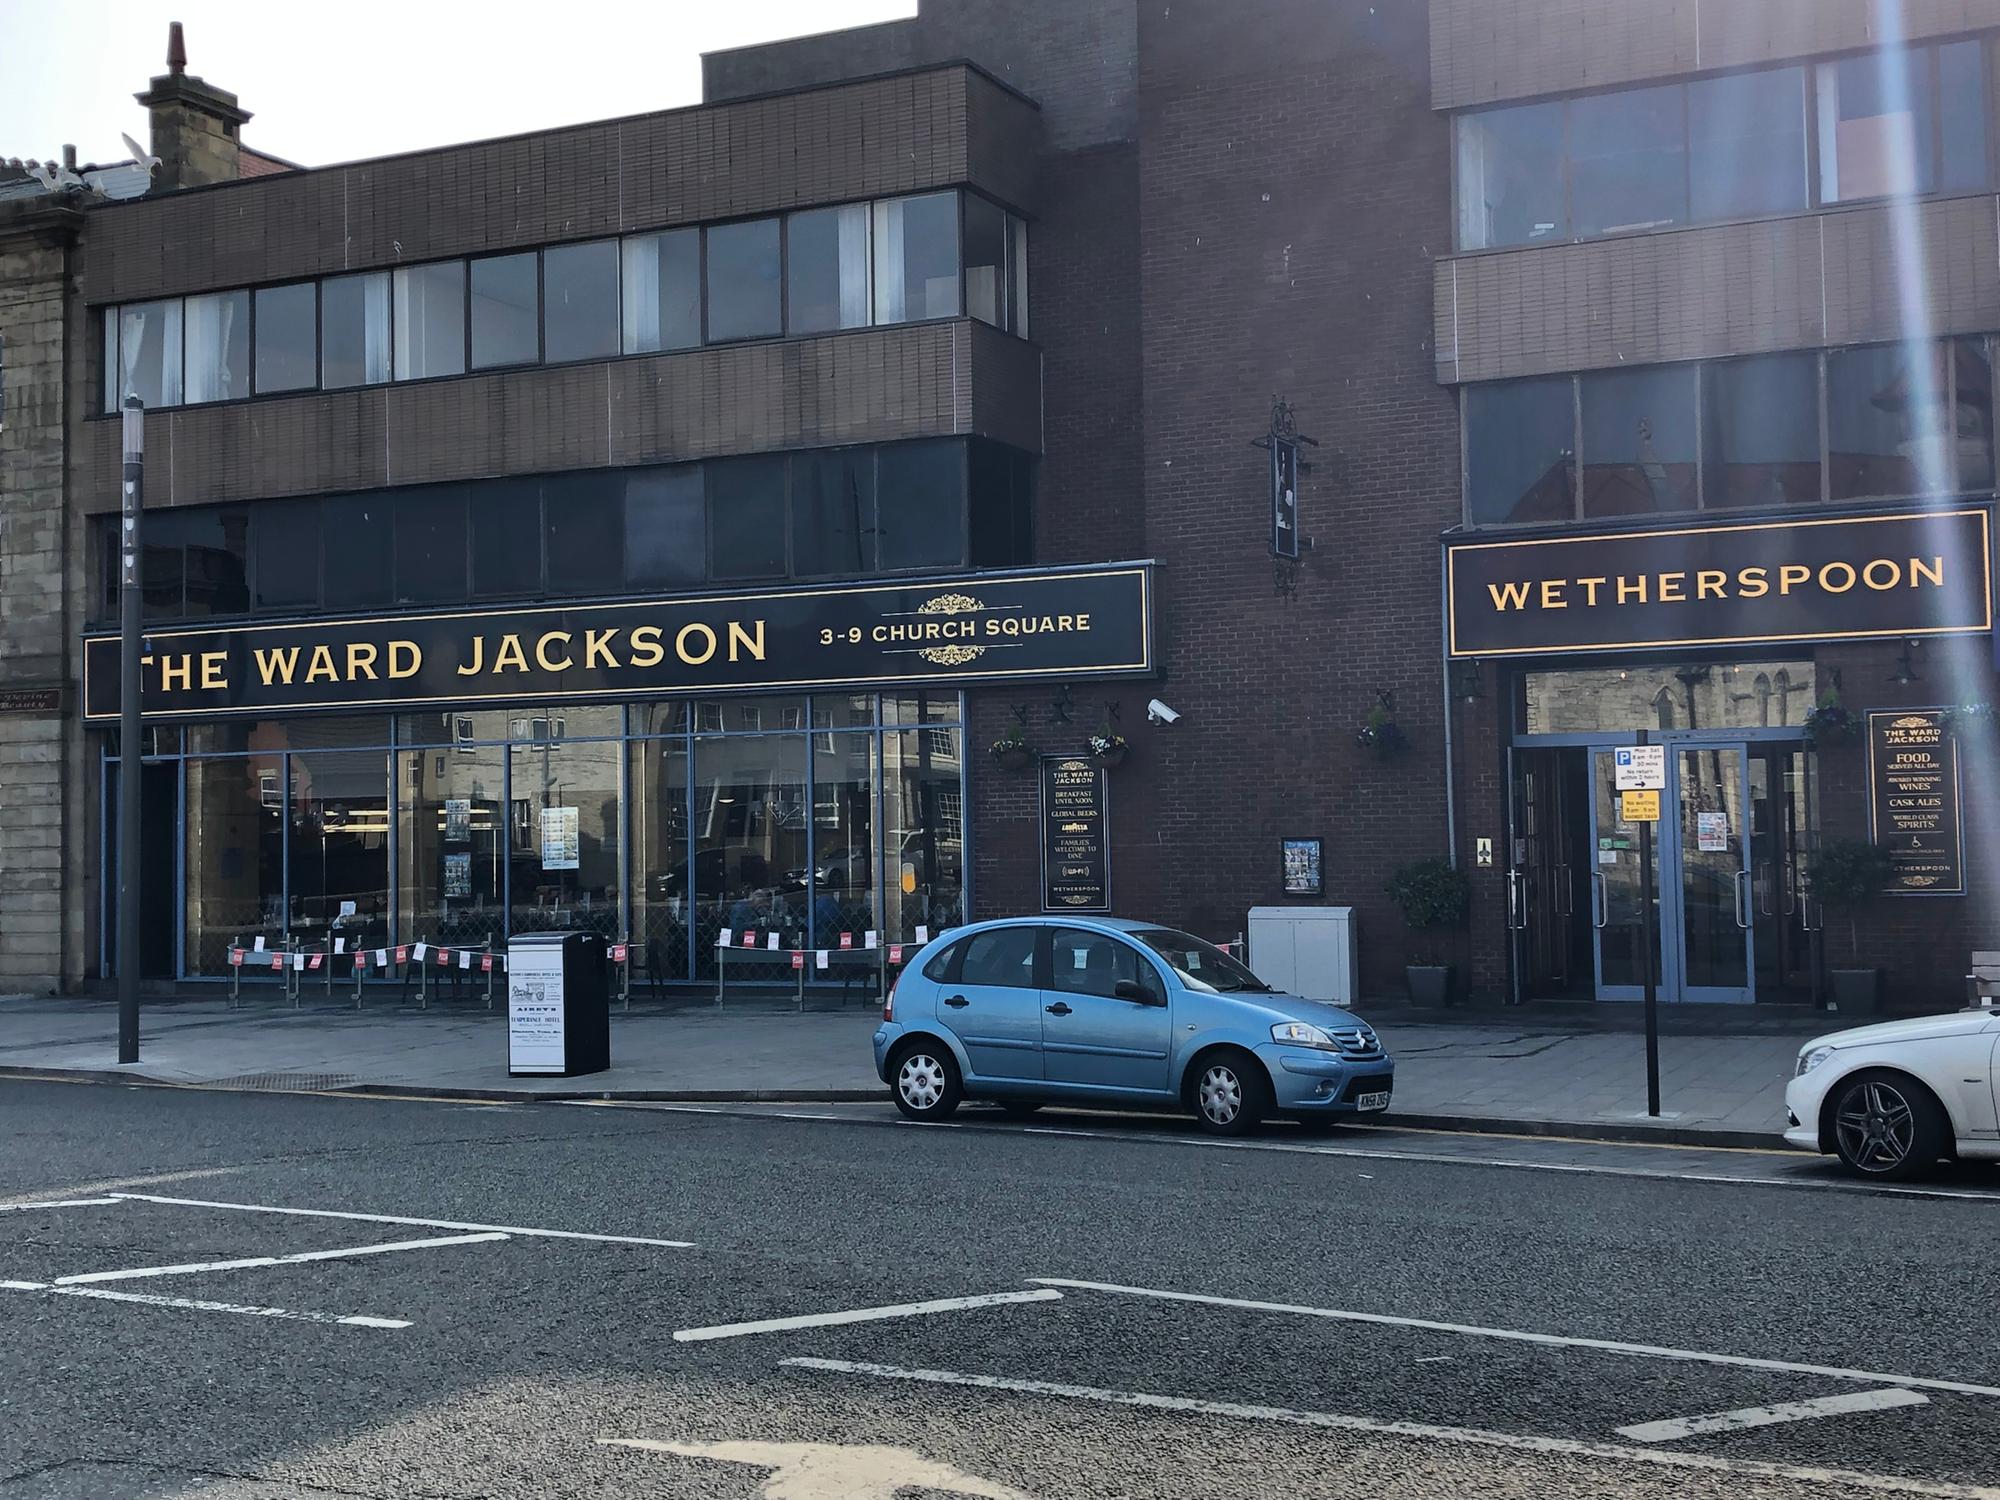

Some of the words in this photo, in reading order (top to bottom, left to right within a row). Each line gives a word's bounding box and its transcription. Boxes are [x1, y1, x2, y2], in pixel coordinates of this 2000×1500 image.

[1487, 556, 1943, 611] WETHERSPOON
[819, 626, 862, 646] 3-9
[872, 620, 976, 643] CHURCH
[985, 613, 1090, 637] SQUARE
[253, 640, 423, 686] WARD
[457, 619, 768, 677] JACKSON
[1909, 728, 1942, 736] WARD
[1887, 735, 1939, 744] JACKSON
[1619, 752, 1630, 764] P
[1896, 752, 1931, 763] FOOD
[1898, 782, 1931, 790] WINES
[1889, 798, 1914, 806] CASK
[1916, 797, 1942, 806] ALES
[1898, 820, 1936, 829] SPIRITS
